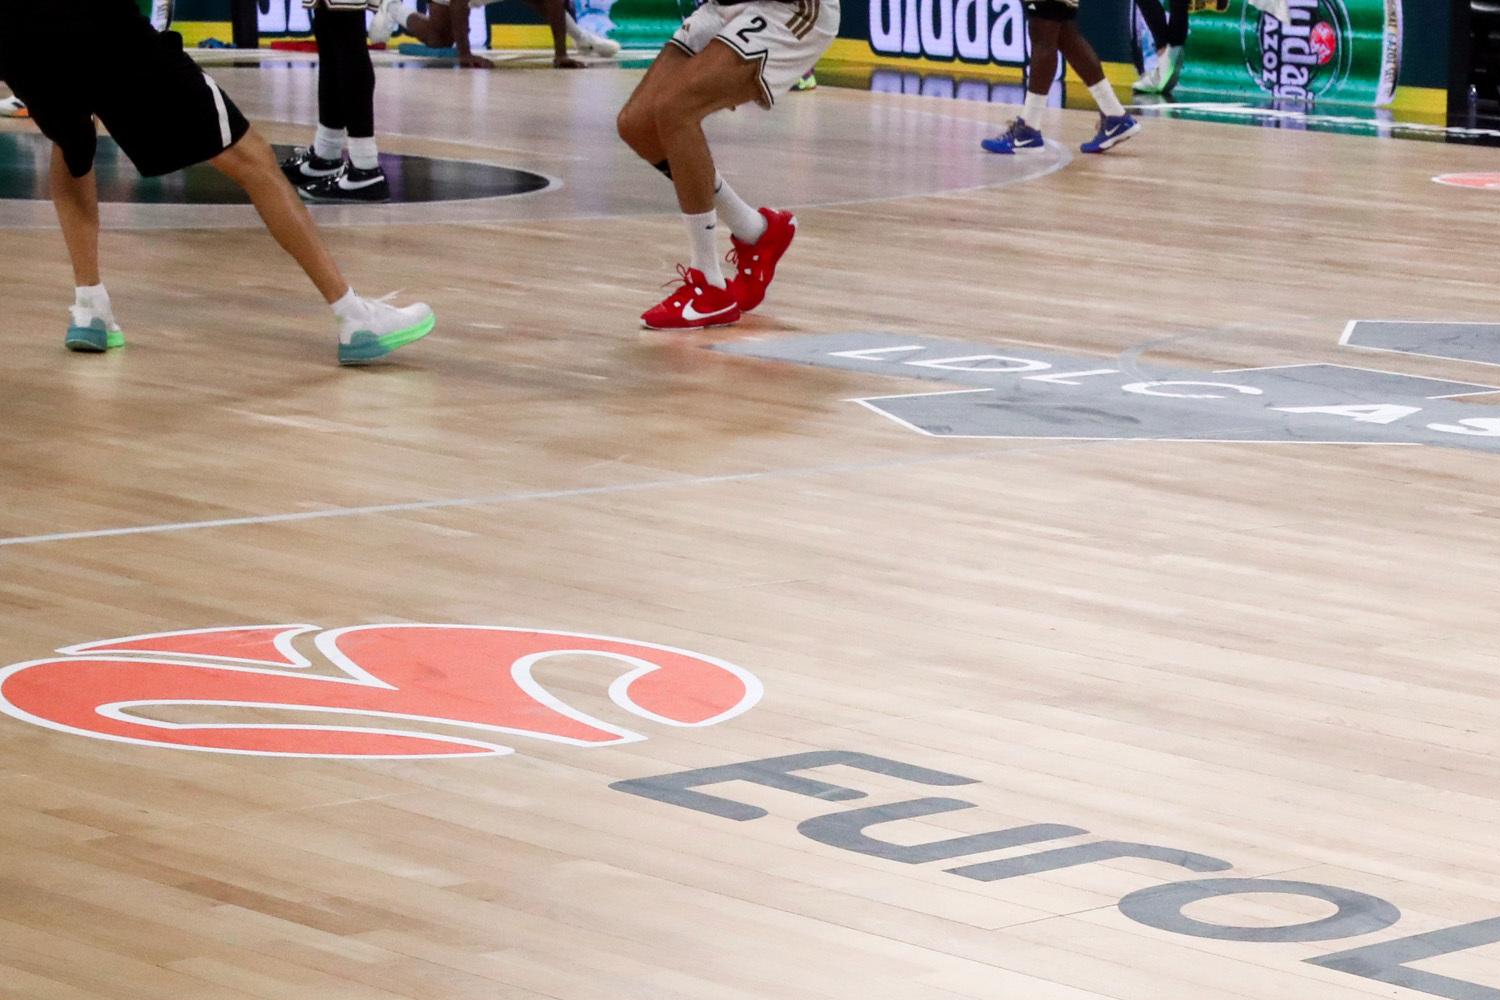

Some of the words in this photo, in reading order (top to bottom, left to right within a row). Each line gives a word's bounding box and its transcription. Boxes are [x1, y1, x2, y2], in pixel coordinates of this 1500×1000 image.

[736, 16, 768, 43] 2
[1262, 13, 1280, 83] AZOZ
[828, 344, 1264, 399] LDLC
